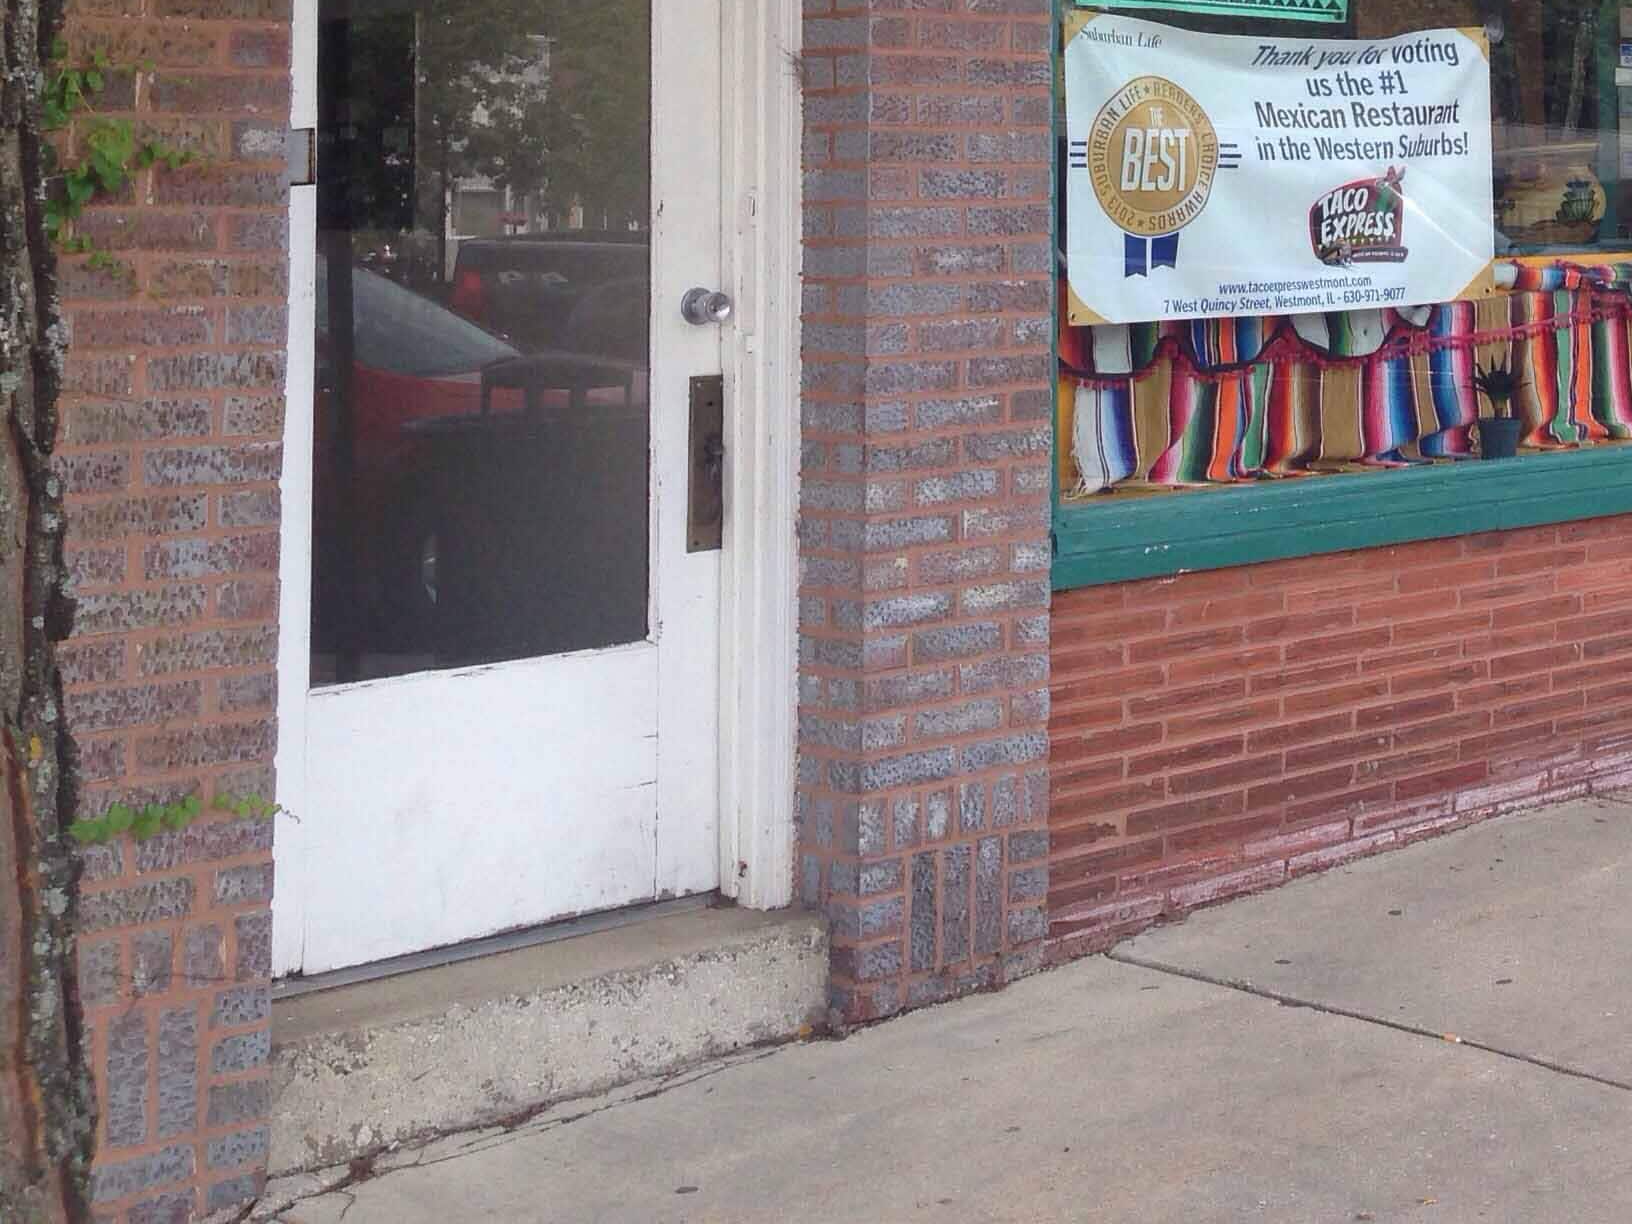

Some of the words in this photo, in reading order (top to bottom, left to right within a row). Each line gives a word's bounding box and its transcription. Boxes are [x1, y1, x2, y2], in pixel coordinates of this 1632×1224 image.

[1080, 28, 1133, 47] Suburban
[1137, 32, 1162, 49] Life
[1251, 45, 1316, 66] Thank
[1313, 51, 1356, 70] you
[1357, 45, 1388, 65] for
[1392, 38, 1459, 66] voting
[1306, 77, 1333, 97] us
[1336, 71, 1374, 96] the
[1379, 70, 1409, 94] #1
[1254, 101, 1346, 128] Mexican
[1351, 99, 1459, 127] Restaurant
[1121, 128, 1192, 192] BEST
[1255, 136, 1275, 160] in
[1279, 136, 1311, 160] the
[1313, 136, 1394, 160] Western
[1398, 132, 1469, 158] Suburbs!
[1149, 190, 1204, 231] AWARDS
[1319, 187, 1369, 219] TACO
[1321, 212, 1394, 248] EXPRESS
[1219, 275, 1372, 295] www.tacoexpresswestmont.com
[1164, 300, 1170, 313] 7
[1172, 298, 1198, 313] West
[1200, 297, 1237, 314] Quincy
[1239, 295, 1272, 311] Street,
[1274, 294, 1325, 309] Westmont,
[1326, 291, 1336, 305] IL
[1343, 287, 1406, 304] 630-971-9077
